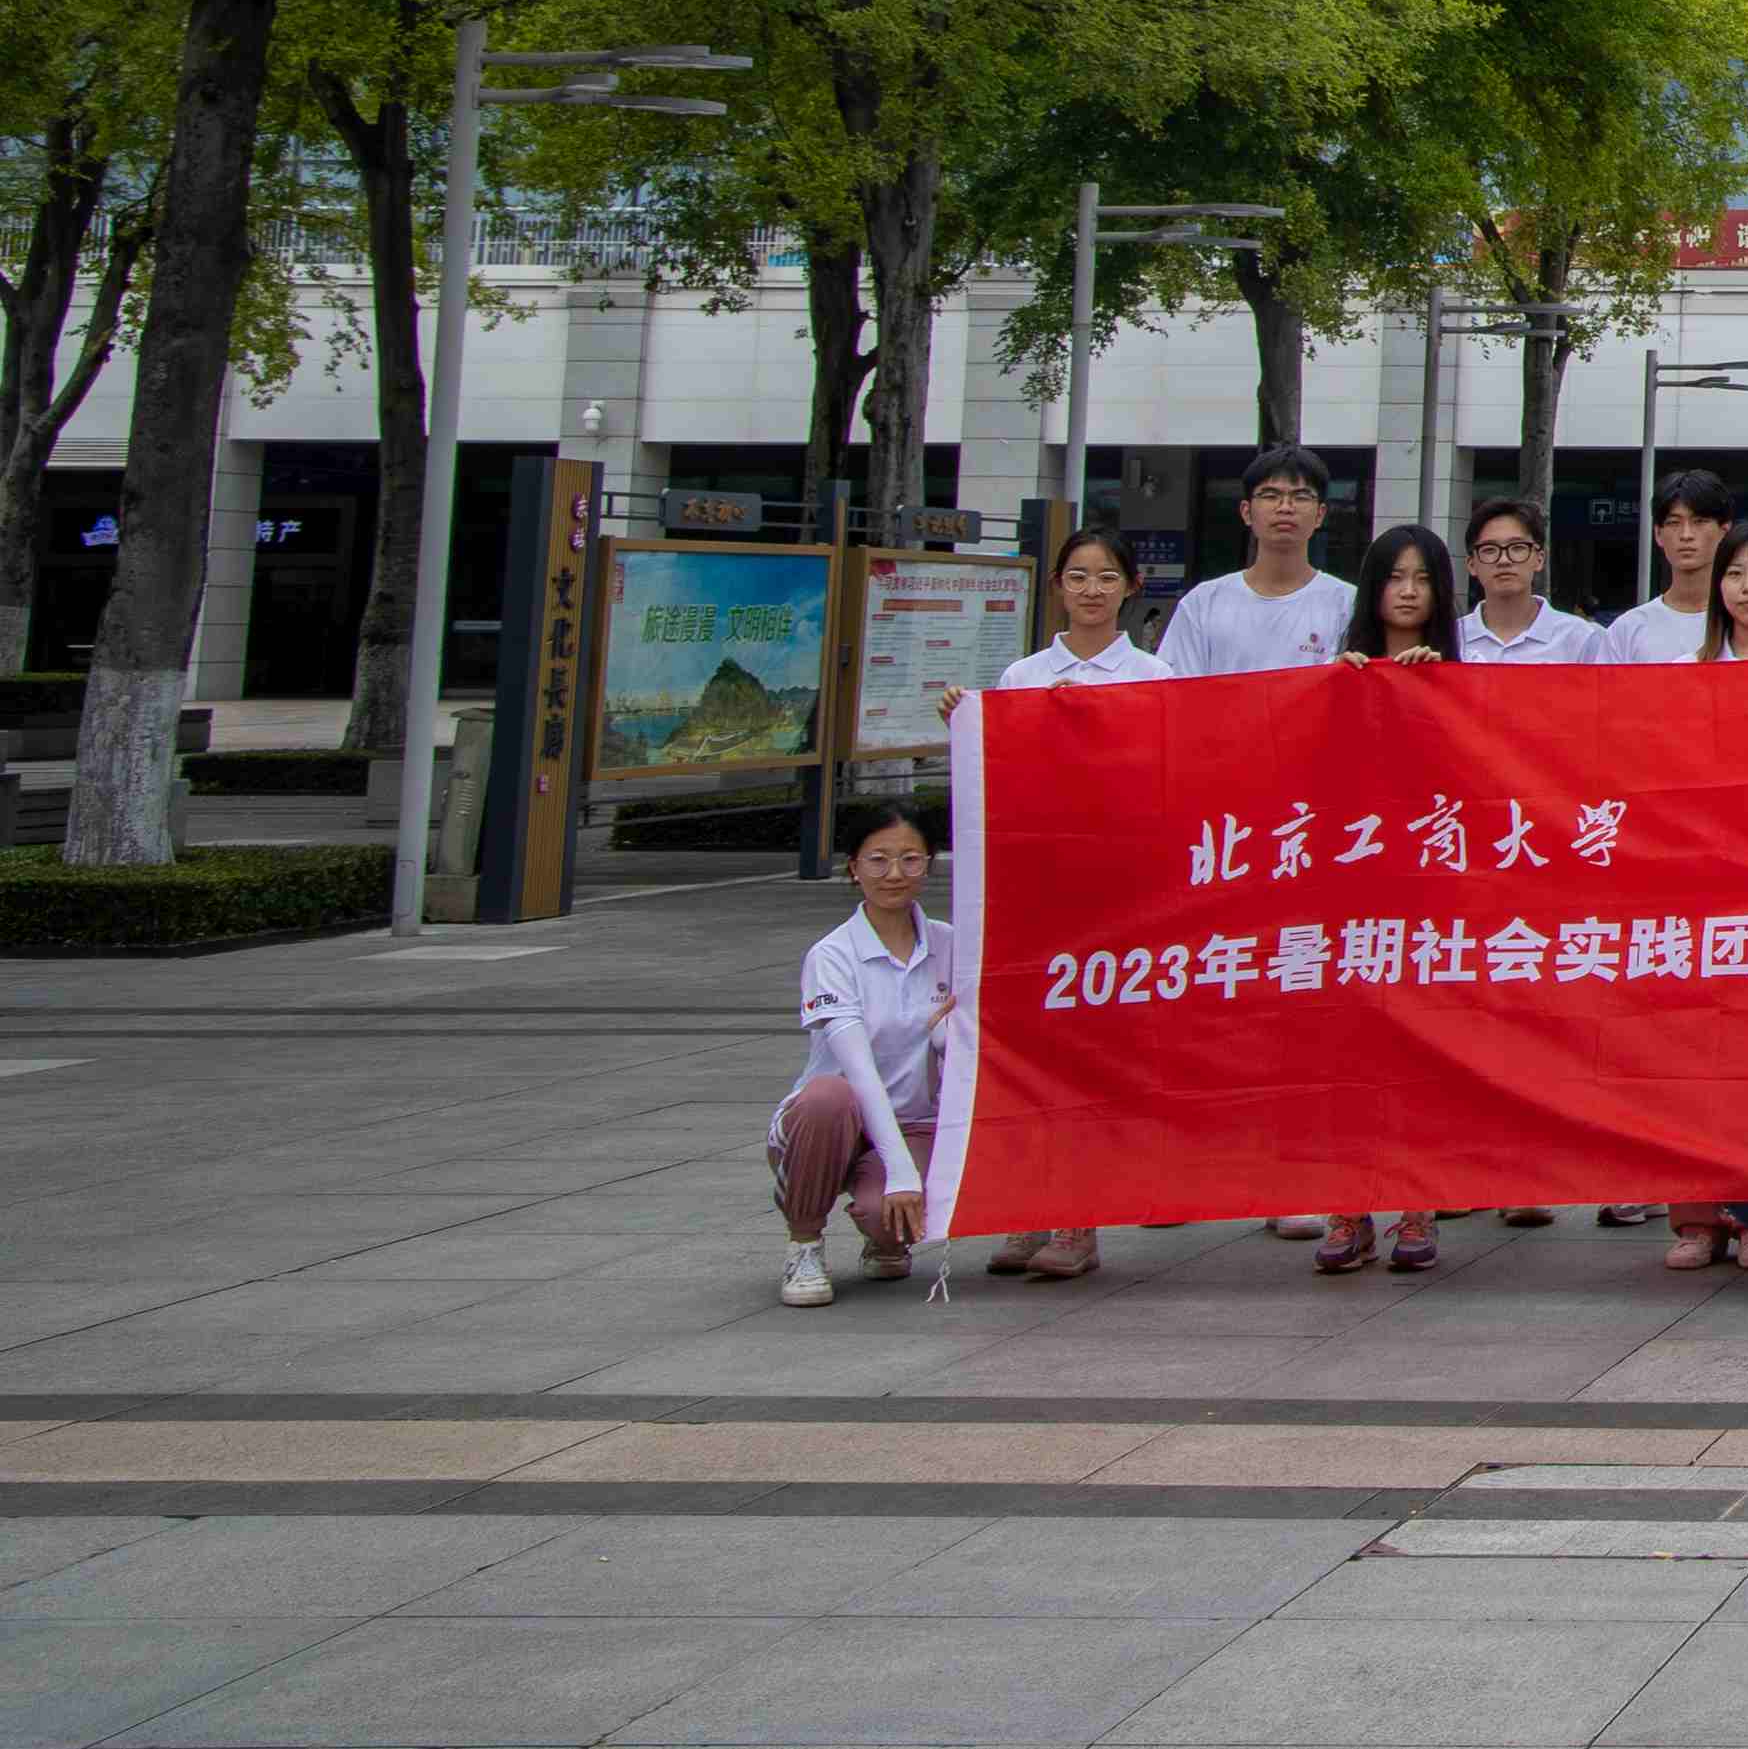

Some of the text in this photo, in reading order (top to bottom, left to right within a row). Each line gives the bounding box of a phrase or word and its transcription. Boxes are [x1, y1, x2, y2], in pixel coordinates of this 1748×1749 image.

[1188, 793, 1628, 886] 北京工商大学
